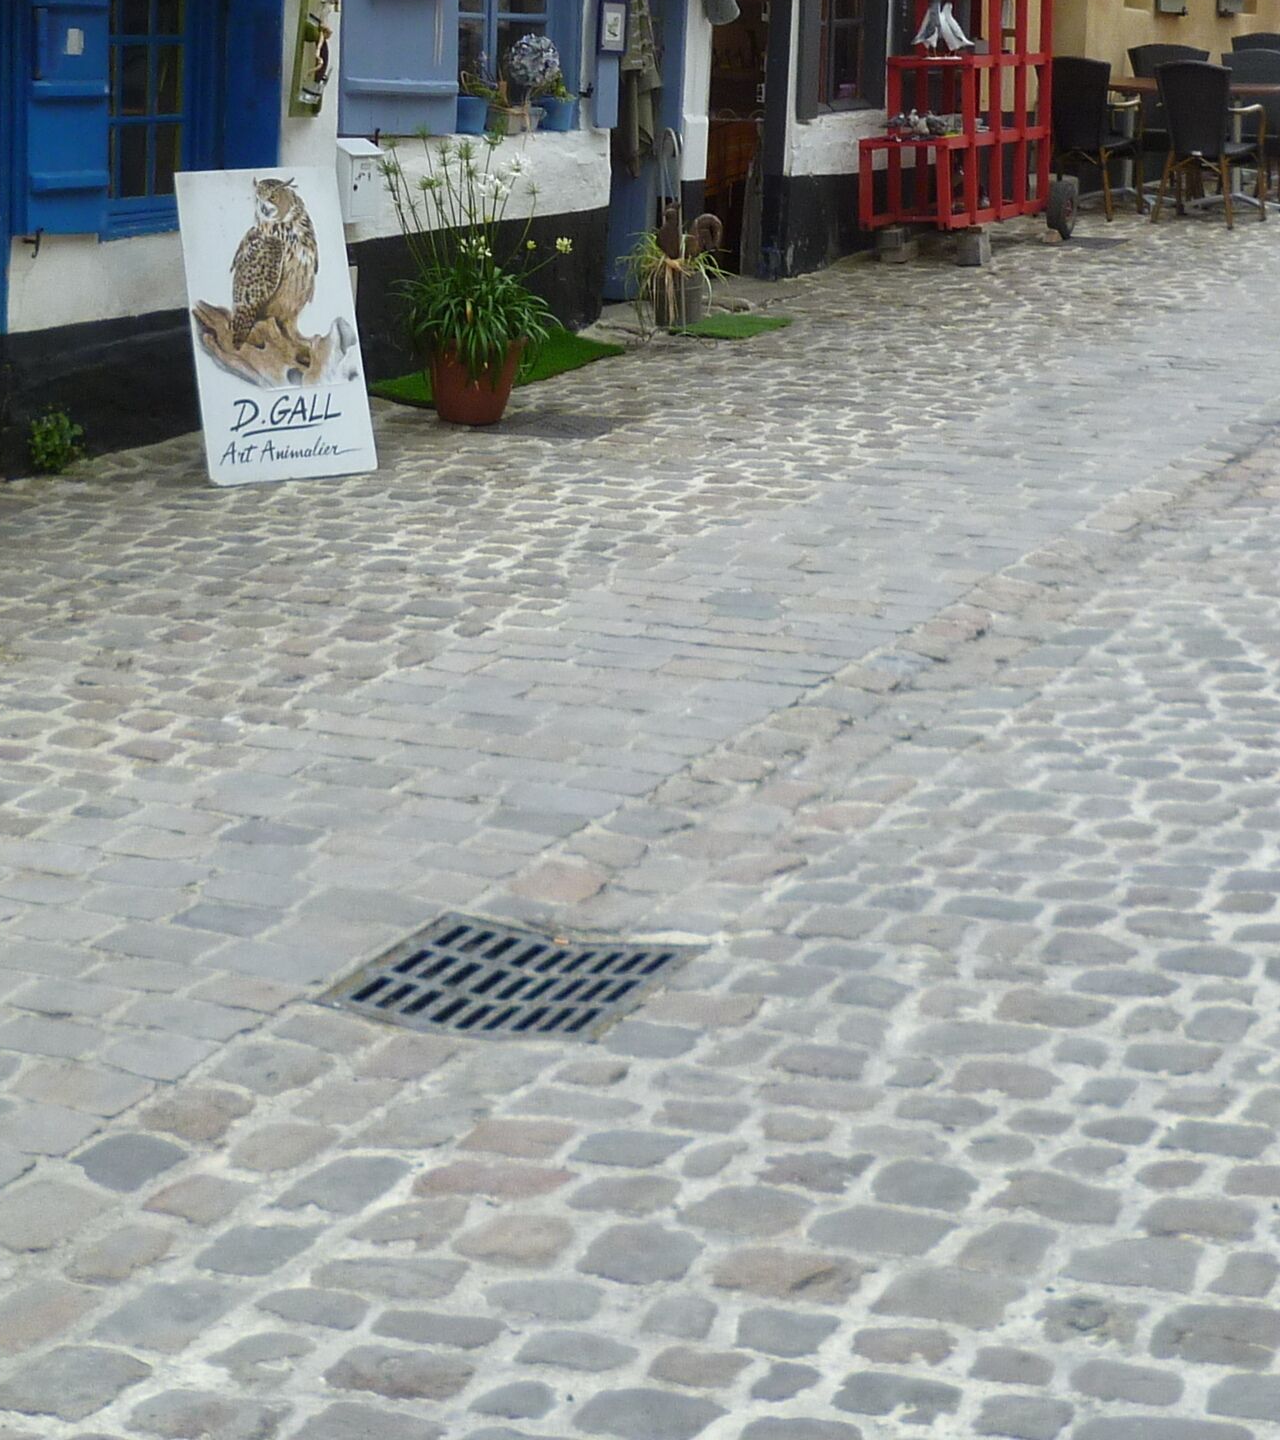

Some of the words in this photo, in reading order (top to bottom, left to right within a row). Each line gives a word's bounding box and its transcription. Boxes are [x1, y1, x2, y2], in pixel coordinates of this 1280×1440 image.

[230, 392, 342, 432] D.GALL
[220, 441, 258, 466] Art
[260, 435, 361, 462] Animalier
